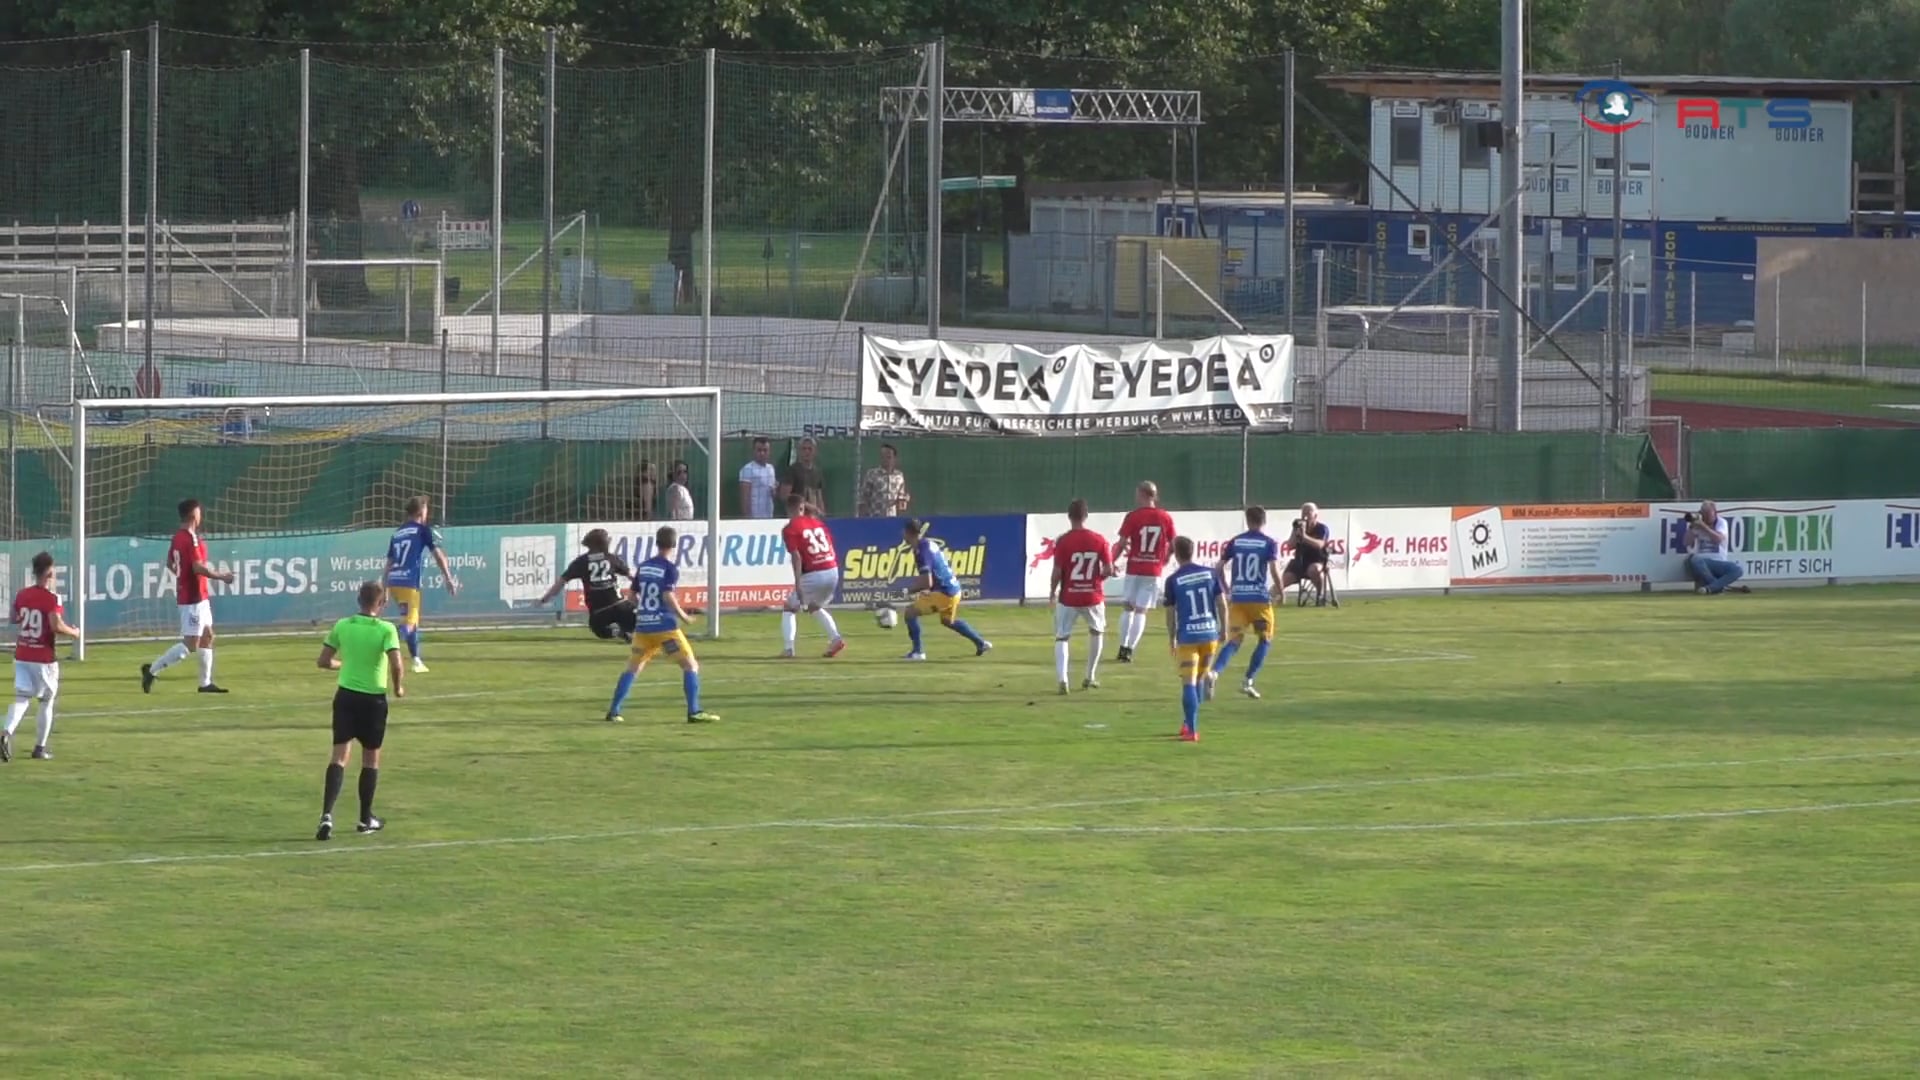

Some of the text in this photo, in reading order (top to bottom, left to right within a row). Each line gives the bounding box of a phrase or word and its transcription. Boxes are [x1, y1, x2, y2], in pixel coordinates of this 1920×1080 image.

[1685, 124, 1735, 140] BODNER
[1775, 127, 1825, 142] BODNER
[1597, 179, 1643, 195] BONER
[1092, 353, 1262, 400] EYEDEA
[874, 411, 896, 423] DIE
[1096, 414, 1159, 427] WERBUNG
[1171, 407, 1274, 424] WWW.EYED.AT
[803, 527, 830, 554] 33
[1139, 526, 1162, 552] 17
[1384, 536, 1448, 554] A. HAAS
[1664, 515, 1833, 554] EOPARK
[505, 551, 546, 567] Hello
[612, 534, 785, 567] AURRUH
[1472, 548, 1498, 570] MM
[331, 556, 350, 570] Wir
[355, 557, 387, 570] setz
[588, 560, 613, 582] 22
[843, 545, 985, 580] Südmall
[1070, 552, 1098, 581] 27
[1236, 553, 1260, 581] 10
[1746, 558, 1833, 575] TRIFFT SICH
[143, 557, 318, 600] FANESS!
[330, 582, 346, 592] so
[505, 569, 550, 585] bank!
[637, 582, 660, 611] 18
[696, 589, 791, 603] FRZEITANLAGE
[1185, 587, 1213, 620] 11
[20, 607, 43, 638] 29
